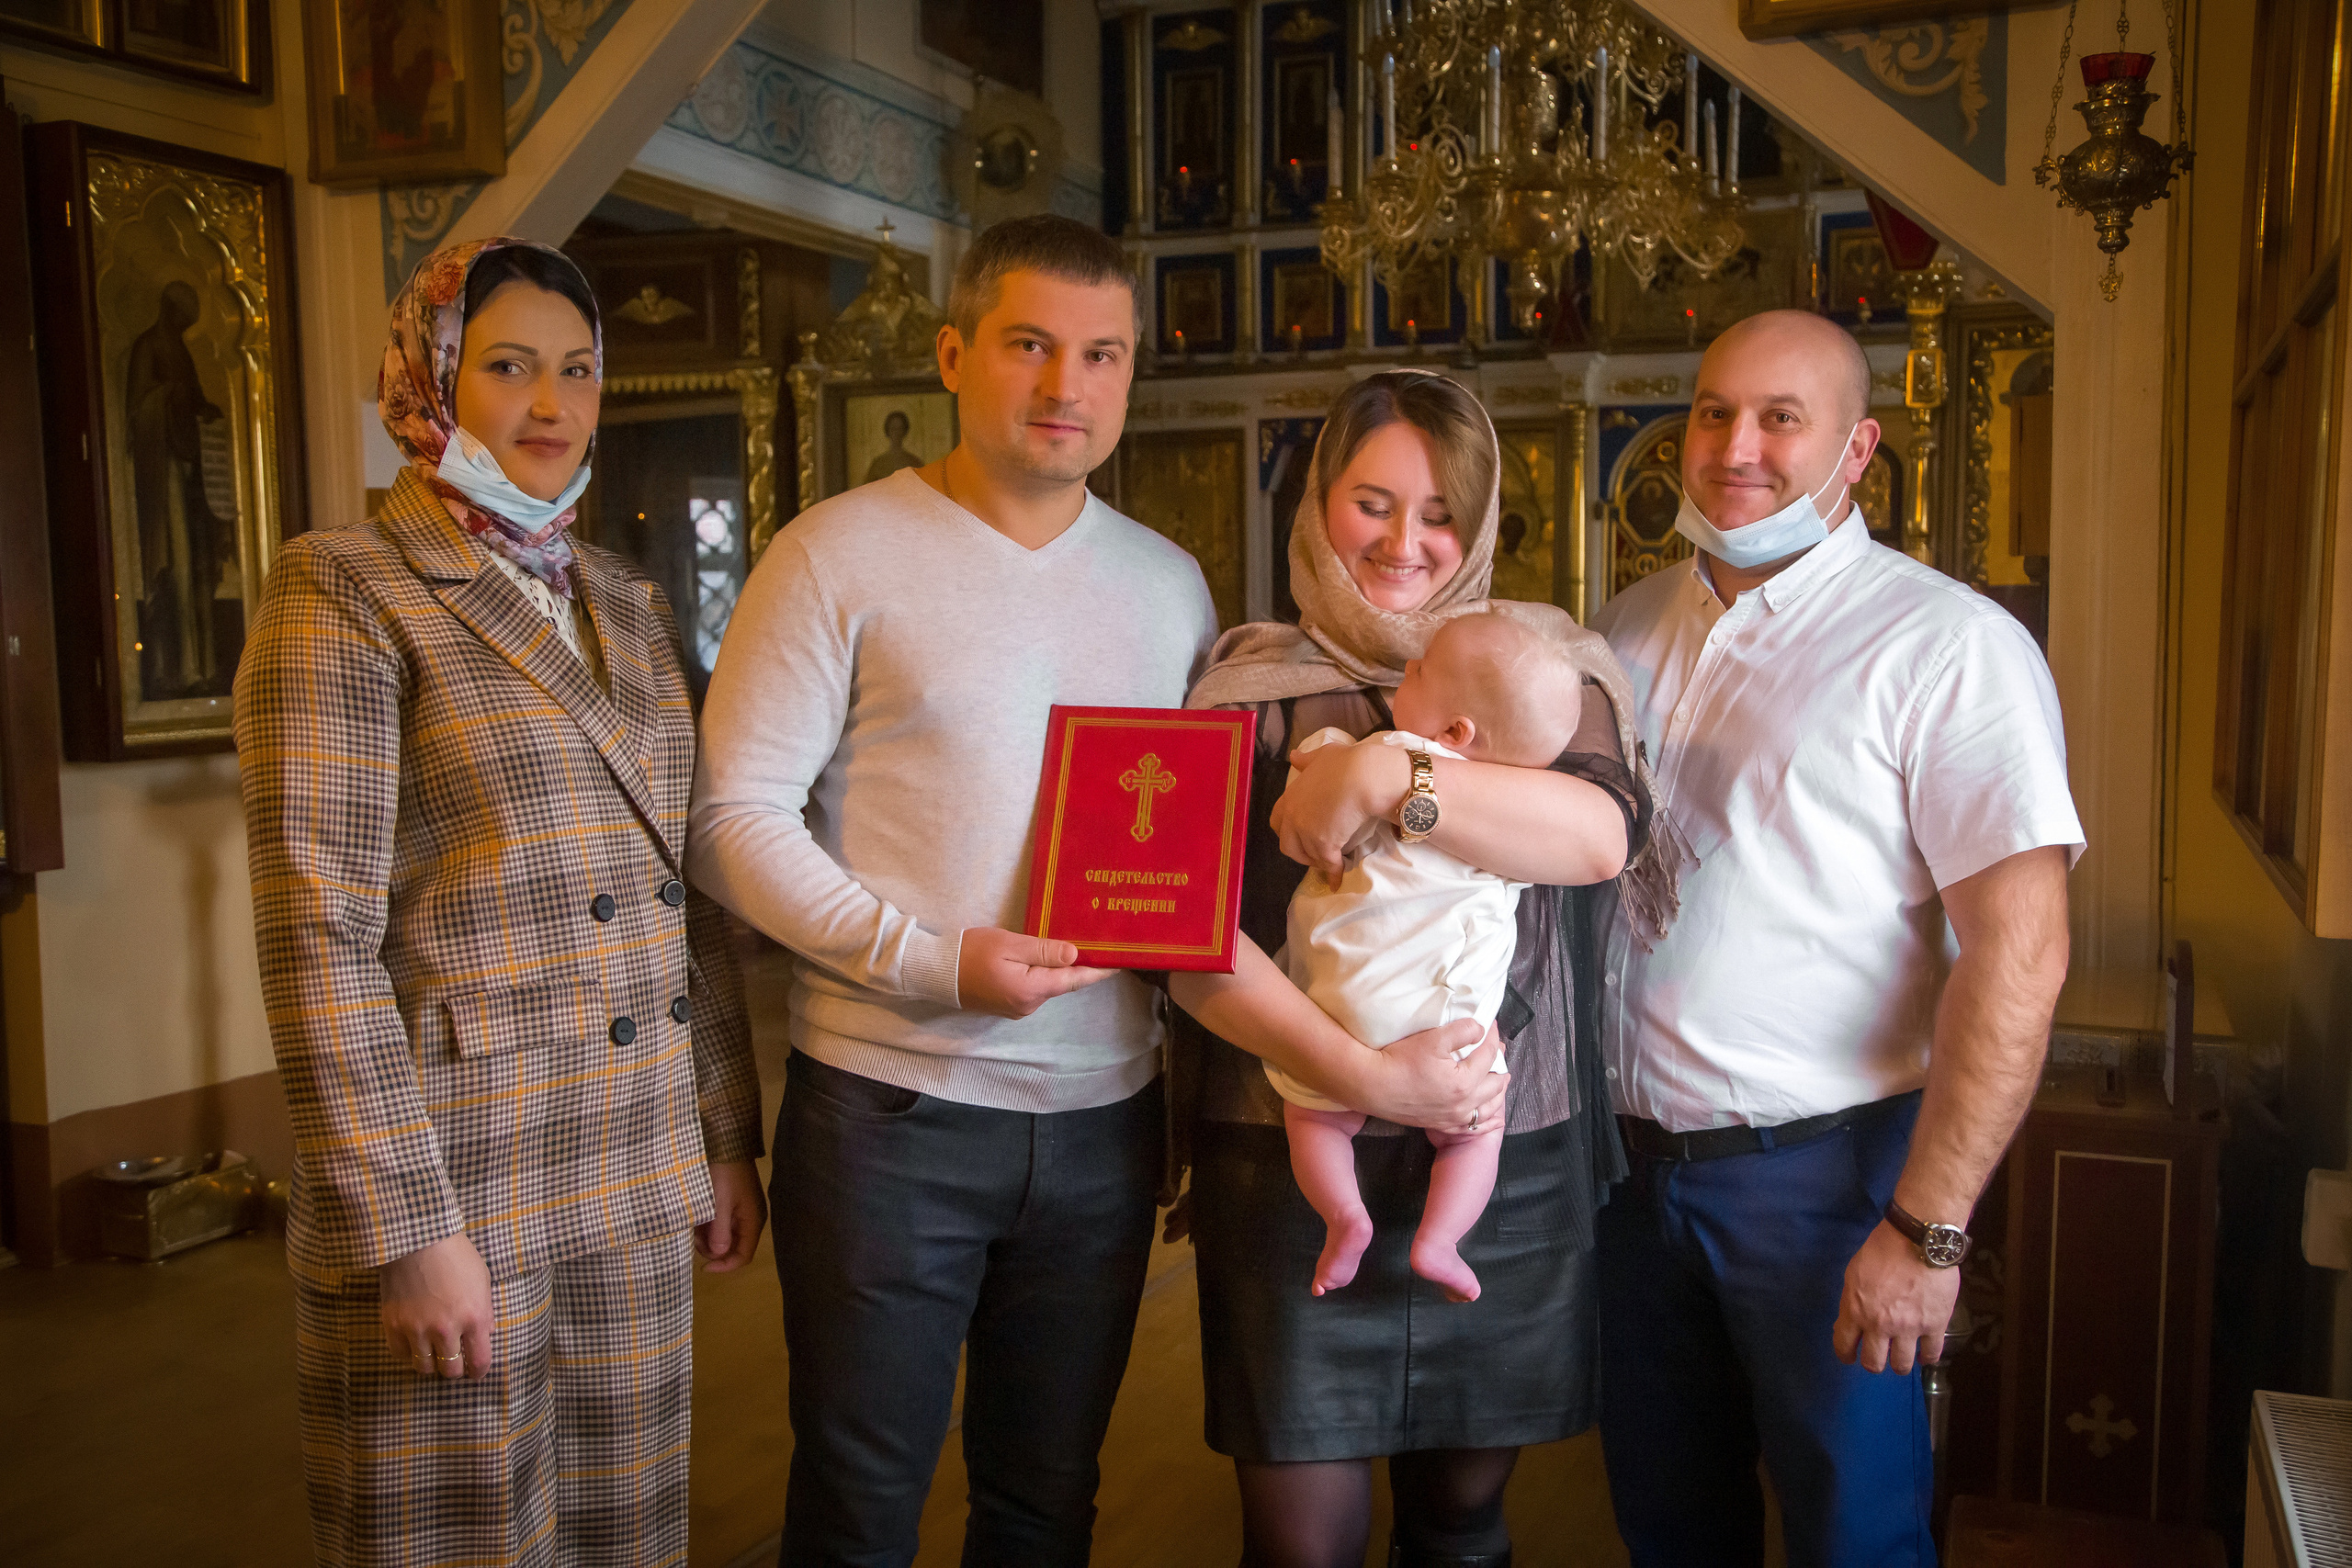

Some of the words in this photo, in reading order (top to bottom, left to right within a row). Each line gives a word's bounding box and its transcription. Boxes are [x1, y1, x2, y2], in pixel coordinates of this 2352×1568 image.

[1085, 869, 1189, 886] СВИДЕТЕЛЬСТВО
[1091, 897, 1100, 909] О
[1107, 897, 1176, 916] КРЕЩЕНИИ
